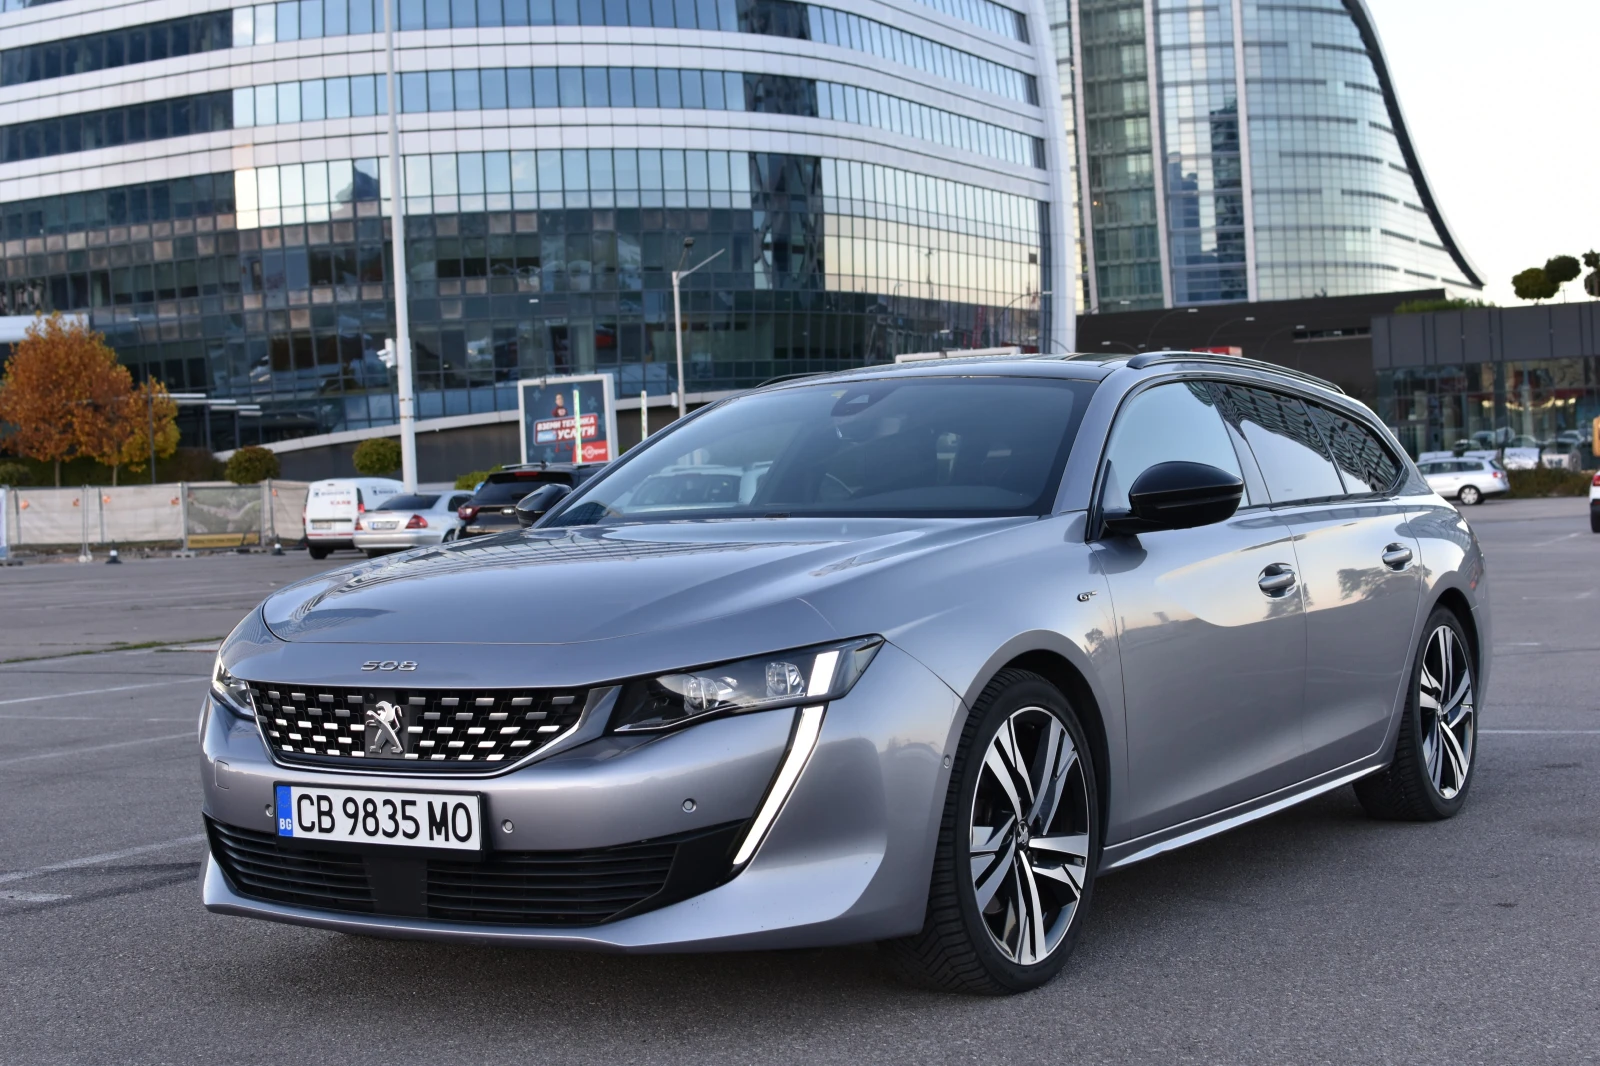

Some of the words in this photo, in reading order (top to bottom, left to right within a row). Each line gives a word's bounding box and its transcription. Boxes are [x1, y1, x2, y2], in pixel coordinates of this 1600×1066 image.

[537, 420, 561, 431] ВЗЕМИ
[562, 416, 595, 428] ТЕХИКА
[558, 425, 595, 440] УСЛГИ
[361, 660, 418, 671] 508
[279, 818, 292, 830] BG
[297, 793, 336, 833] CB
[342, 796, 420, 839] 9835
[427, 801, 473, 842] MO
